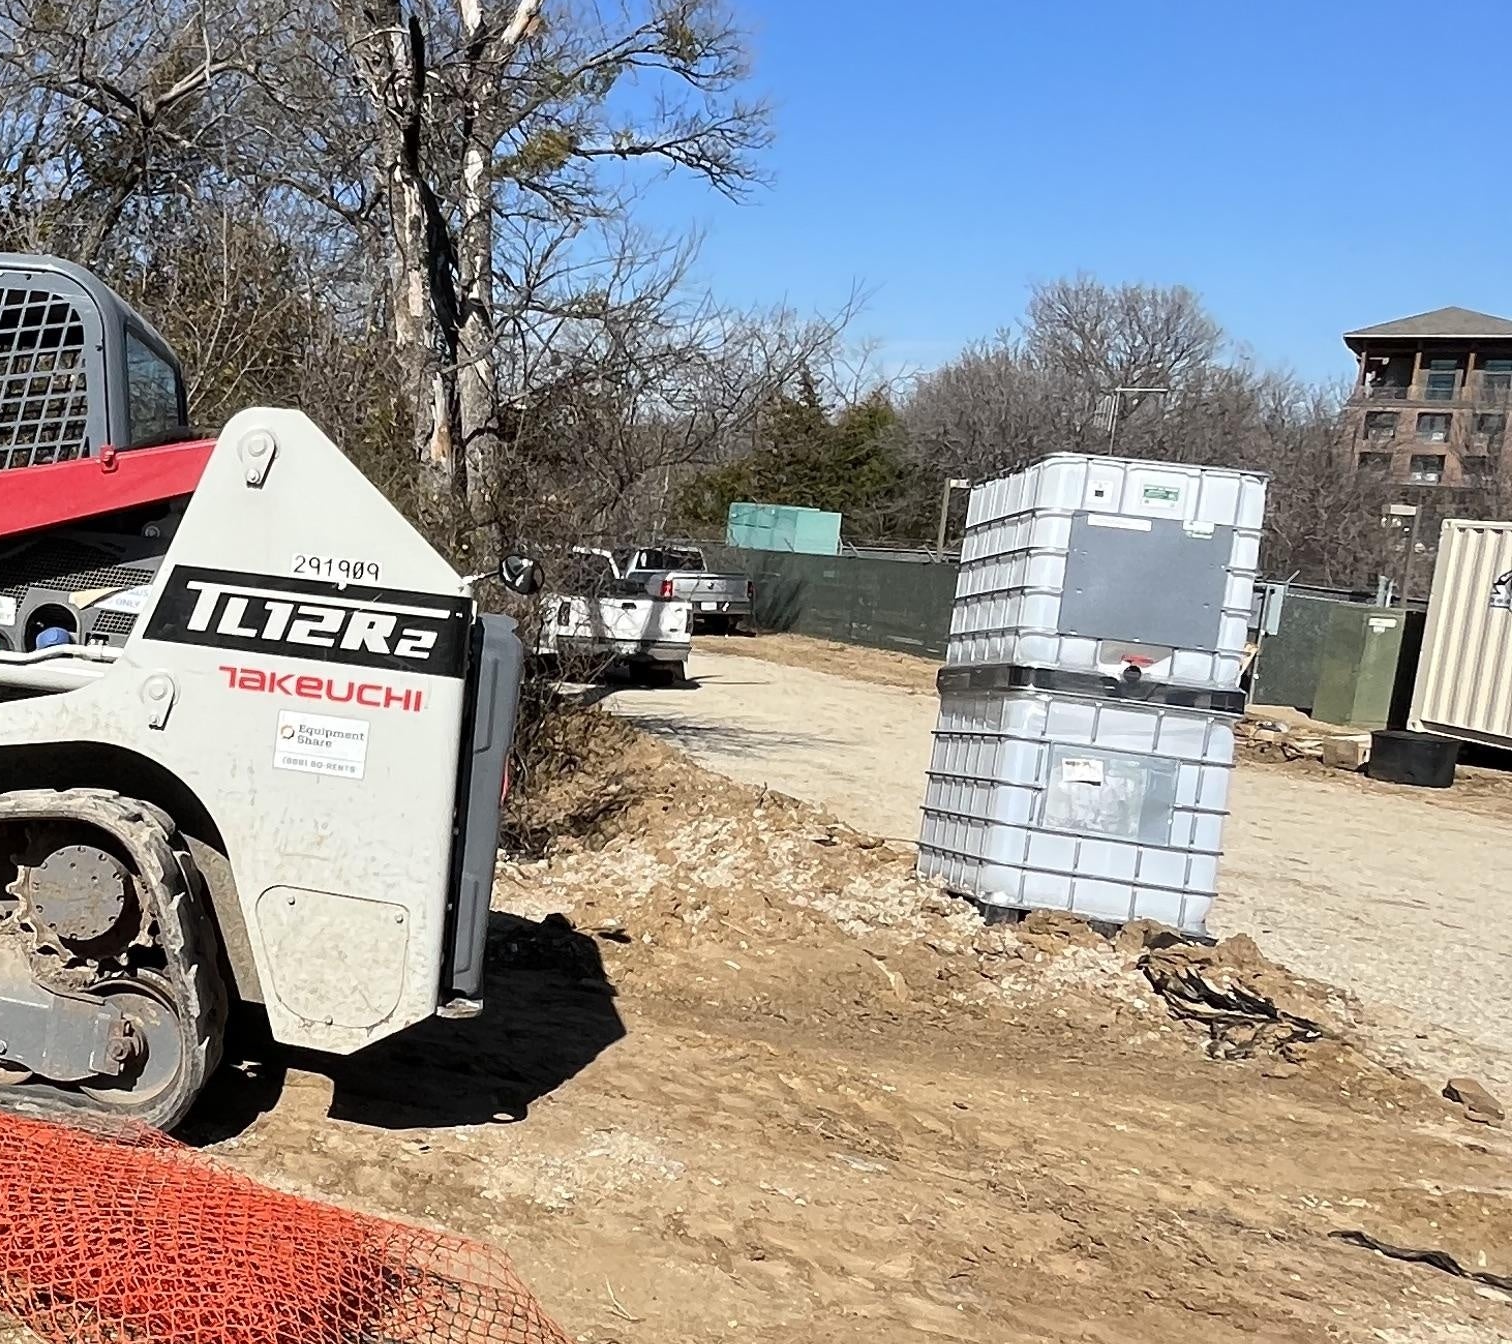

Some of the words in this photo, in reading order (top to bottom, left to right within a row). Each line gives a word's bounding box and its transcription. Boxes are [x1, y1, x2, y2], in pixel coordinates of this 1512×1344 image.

[293, 554, 380, 581] 291909
[297, 734, 333, 748] Share
[298, 724, 365, 741] Equipment
